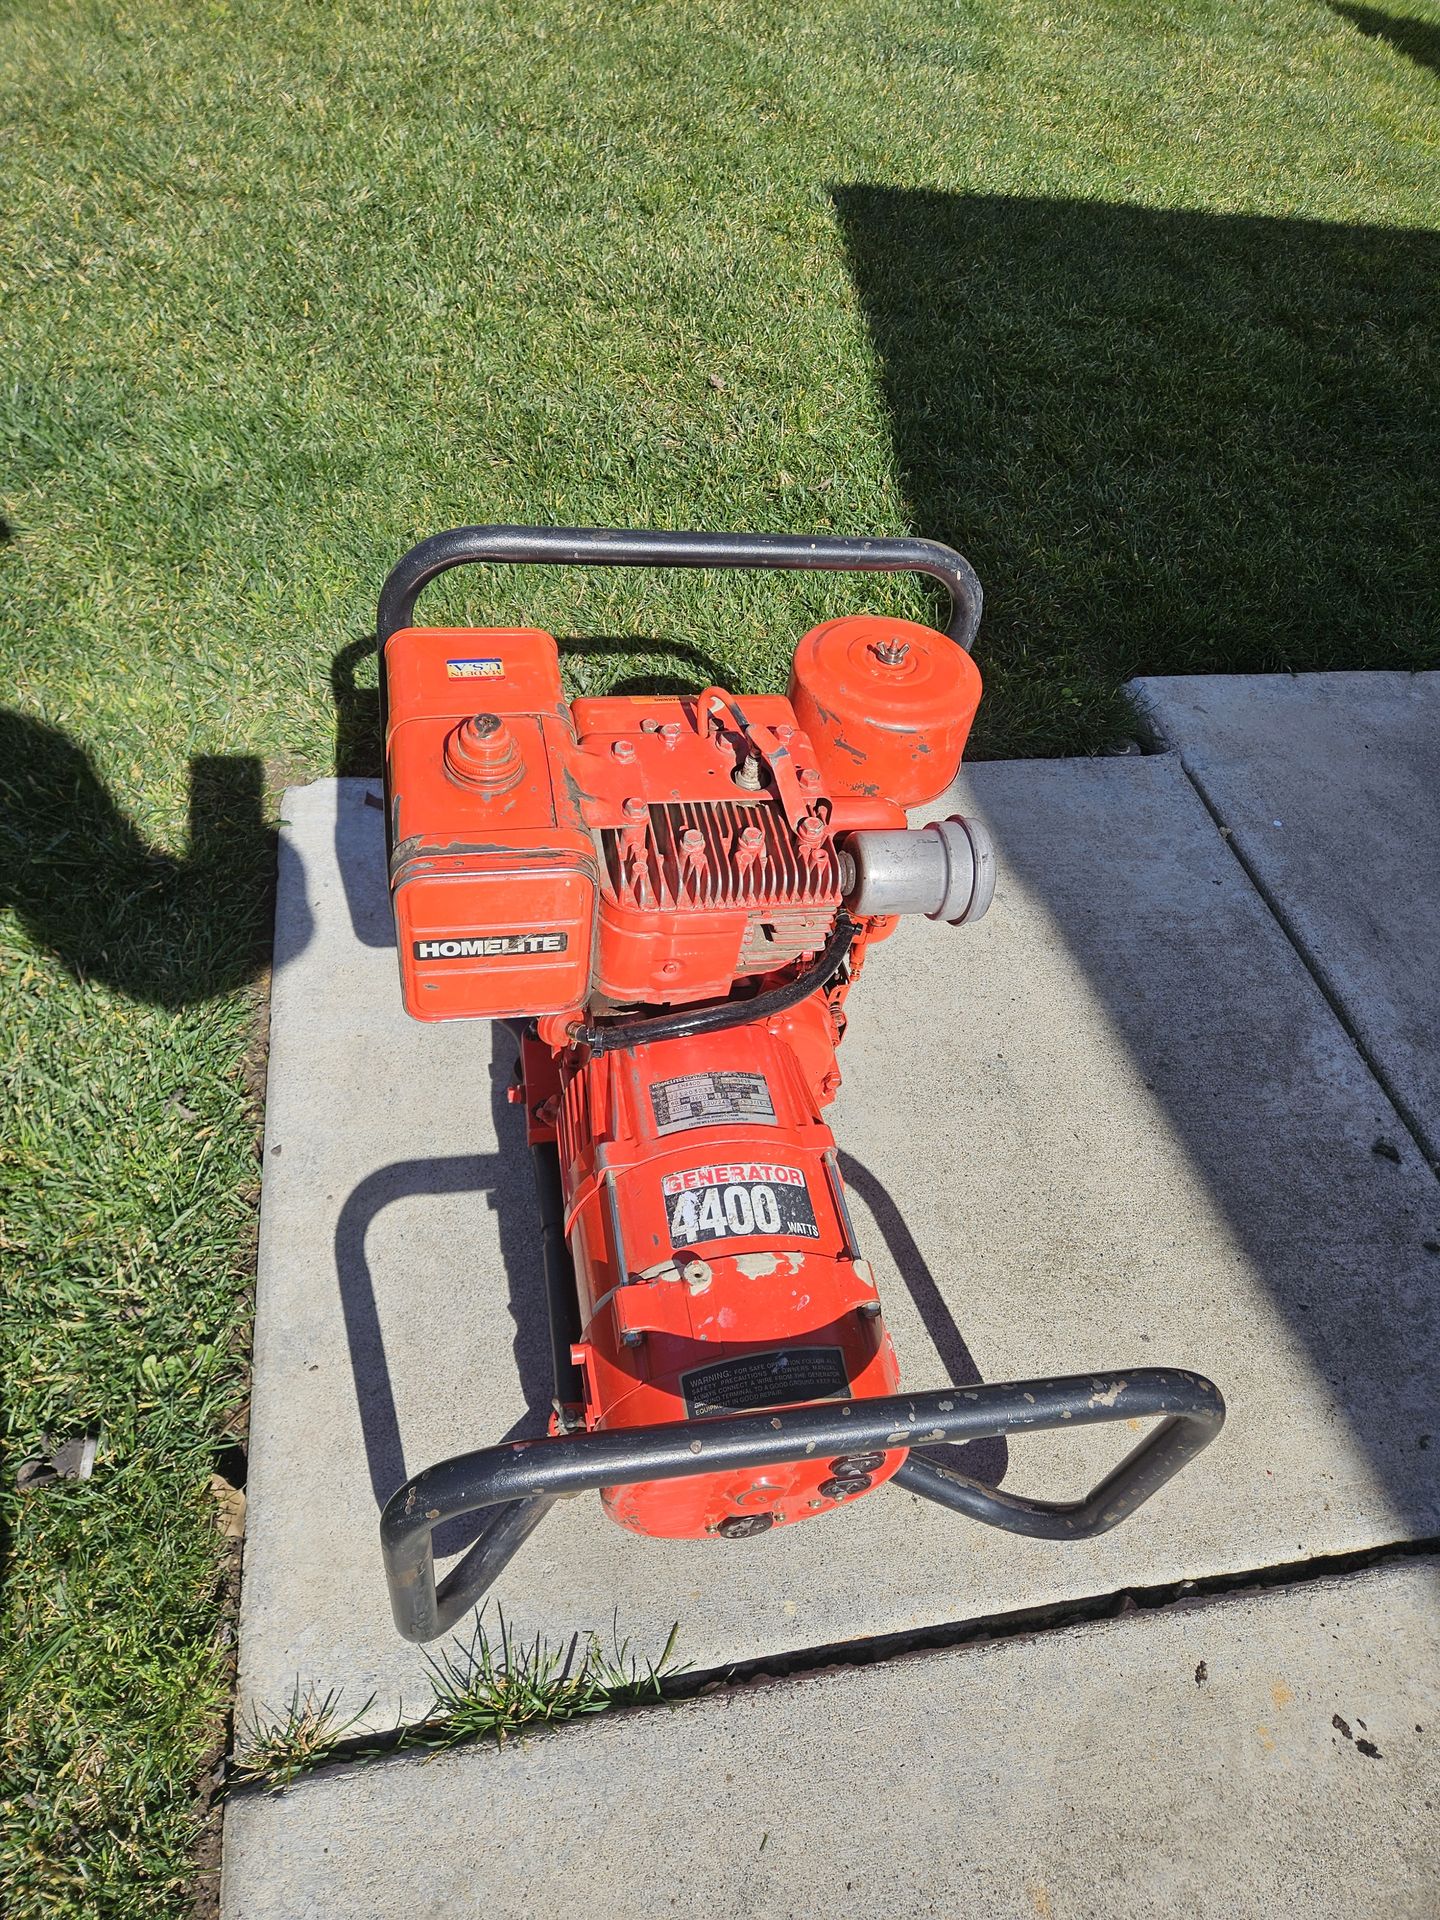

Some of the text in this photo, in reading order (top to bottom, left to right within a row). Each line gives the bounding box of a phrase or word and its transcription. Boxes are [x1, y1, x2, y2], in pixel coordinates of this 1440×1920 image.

[449, 663, 500, 671] U.S.A.
[419, 936, 561, 958] HOMELITE
[667, 1166, 803, 1193] GENERATOR
[671, 1185, 819, 1243] 4400 WATTS
[690, 1370, 732, 1388] WARNING:
[734, 1367, 748, 1375] FOR
[749, 1363, 765, 1372] SAFE
[691, 1382, 716, 1395] SAFETY
[720, 1371, 768, 1386] PRECAUTIONS
[693, 1391, 717, 1402] ALWAYS
[719, 1380, 748, 1394] CONNECT
[757, 1376, 773, 1384] WIRE
[774, 1373, 793, 1382] FROM
[722, 1388, 753, 1400] TERMINAL
[770, 1381, 788, 1390] GOOD
[695, 1400, 730, 1416] EQUIPMENT
[739, 1394, 759, 1403] GOOD
